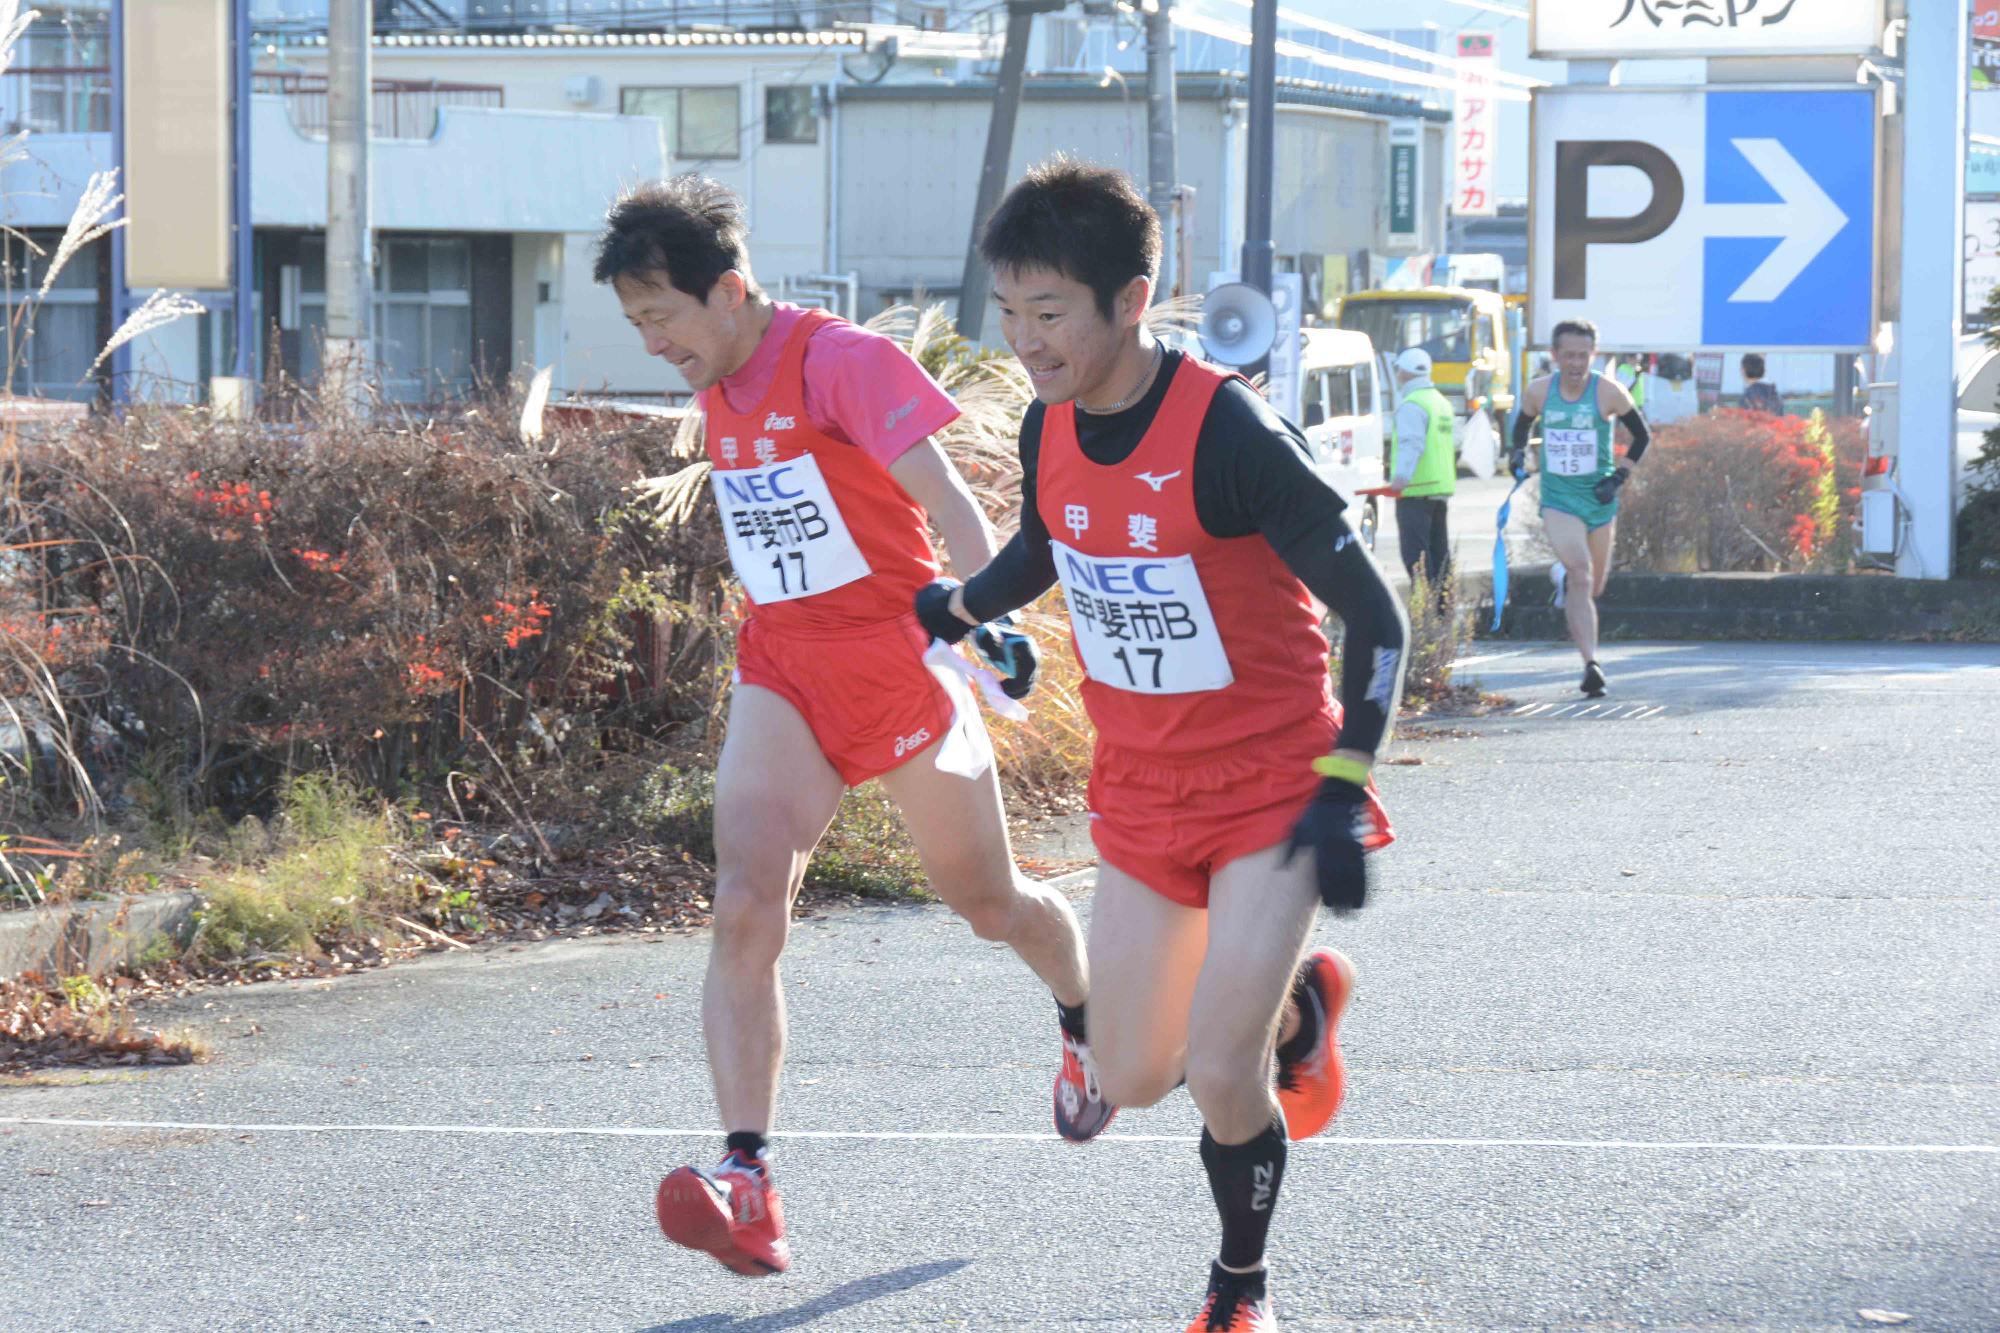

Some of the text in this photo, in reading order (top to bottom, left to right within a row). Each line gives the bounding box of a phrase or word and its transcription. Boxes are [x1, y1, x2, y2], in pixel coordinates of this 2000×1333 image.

[1462, 98, 1486, 209] アカサカ
[1554, 139, 1684, 299] P
[767, 412, 796, 431] asics
[1550, 431, 1590, 442] NEC
[724, 467, 804, 504] NEC
[1561, 460, 1579, 473] 15
[772, 552, 808, 594] 17
[1066, 552, 1175, 595] NEC
[1071, 587, 1198, 642] 甲斐市B
[1113, 647, 1164, 688] 17
[898, 727, 930, 755] asics
